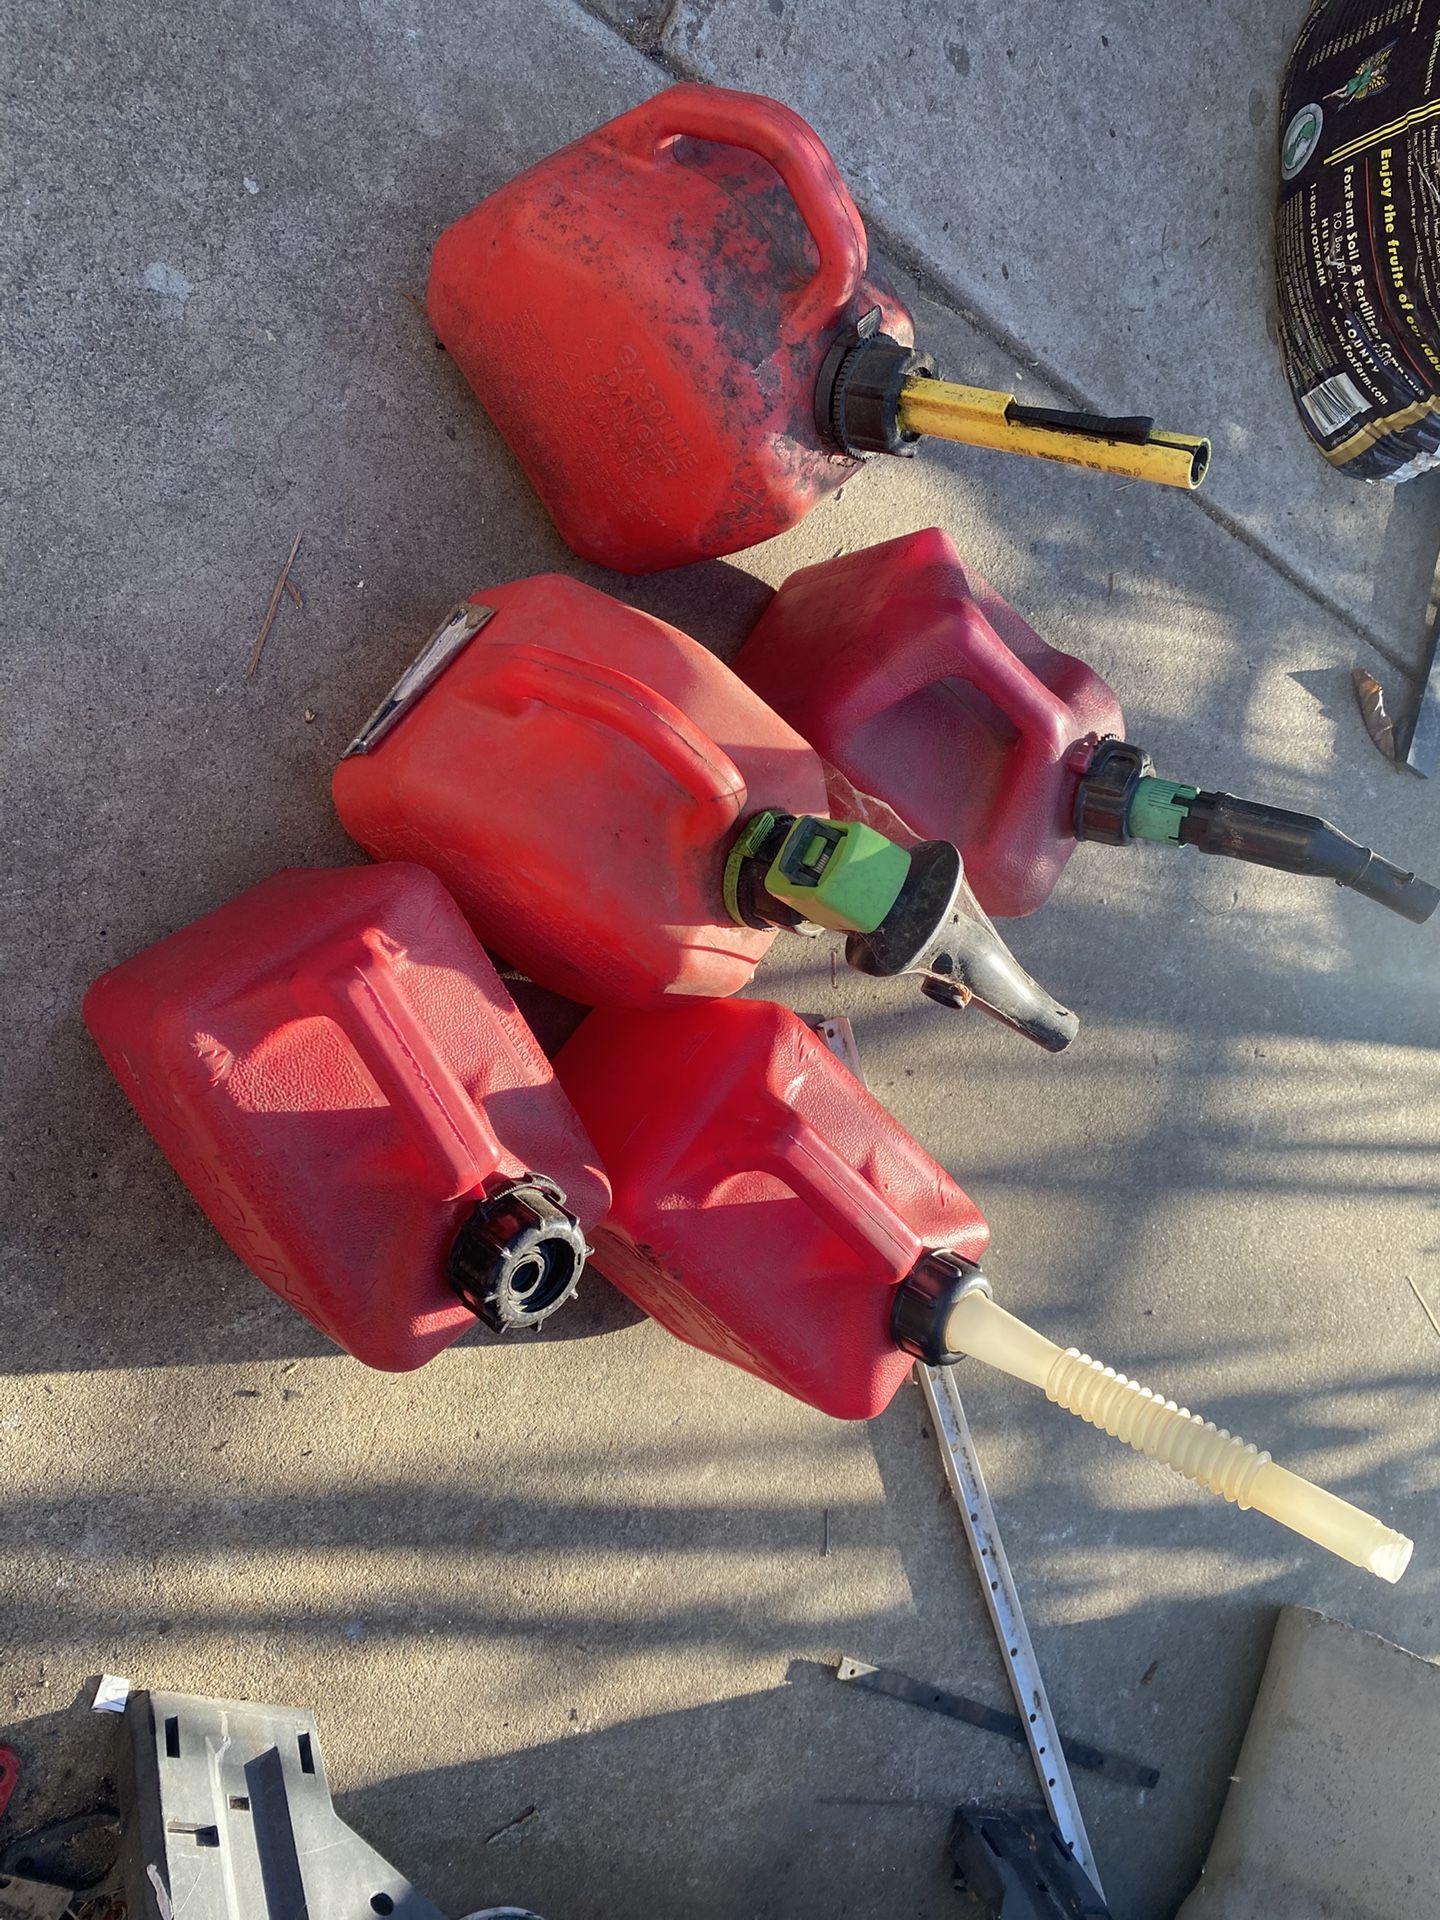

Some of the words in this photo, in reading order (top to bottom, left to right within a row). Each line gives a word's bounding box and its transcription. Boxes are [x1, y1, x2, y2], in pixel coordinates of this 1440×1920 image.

[1343, 164, 1356, 229] FoxFarm
[1379, 148, 1393, 198] Enjoy
[1384, 204, 1397, 233] the
[1334, 235, 1344, 254] Box
[1346, 232, 1360, 261] Soil
[1387, 239, 1404, 288] fruits
[1309, 183, 1327, 287] 1-800-4FOXFARM
[1330, 316, 1389, 405] www.FoxFarm.com
[1350, 264, 1362, 276] &
[1321, 217, 1344, 309] HUMOLT
[1344, 319, 1379, 373] COUNTY
[1353, 279, 1382, 340] Fertilizer
[1398, 293, 1414, 310] of
[1420, 343, 1440, 376] labo
[605, 367, 678, 478] DANGER
[619, 344, 699, 471] GASOLINE
